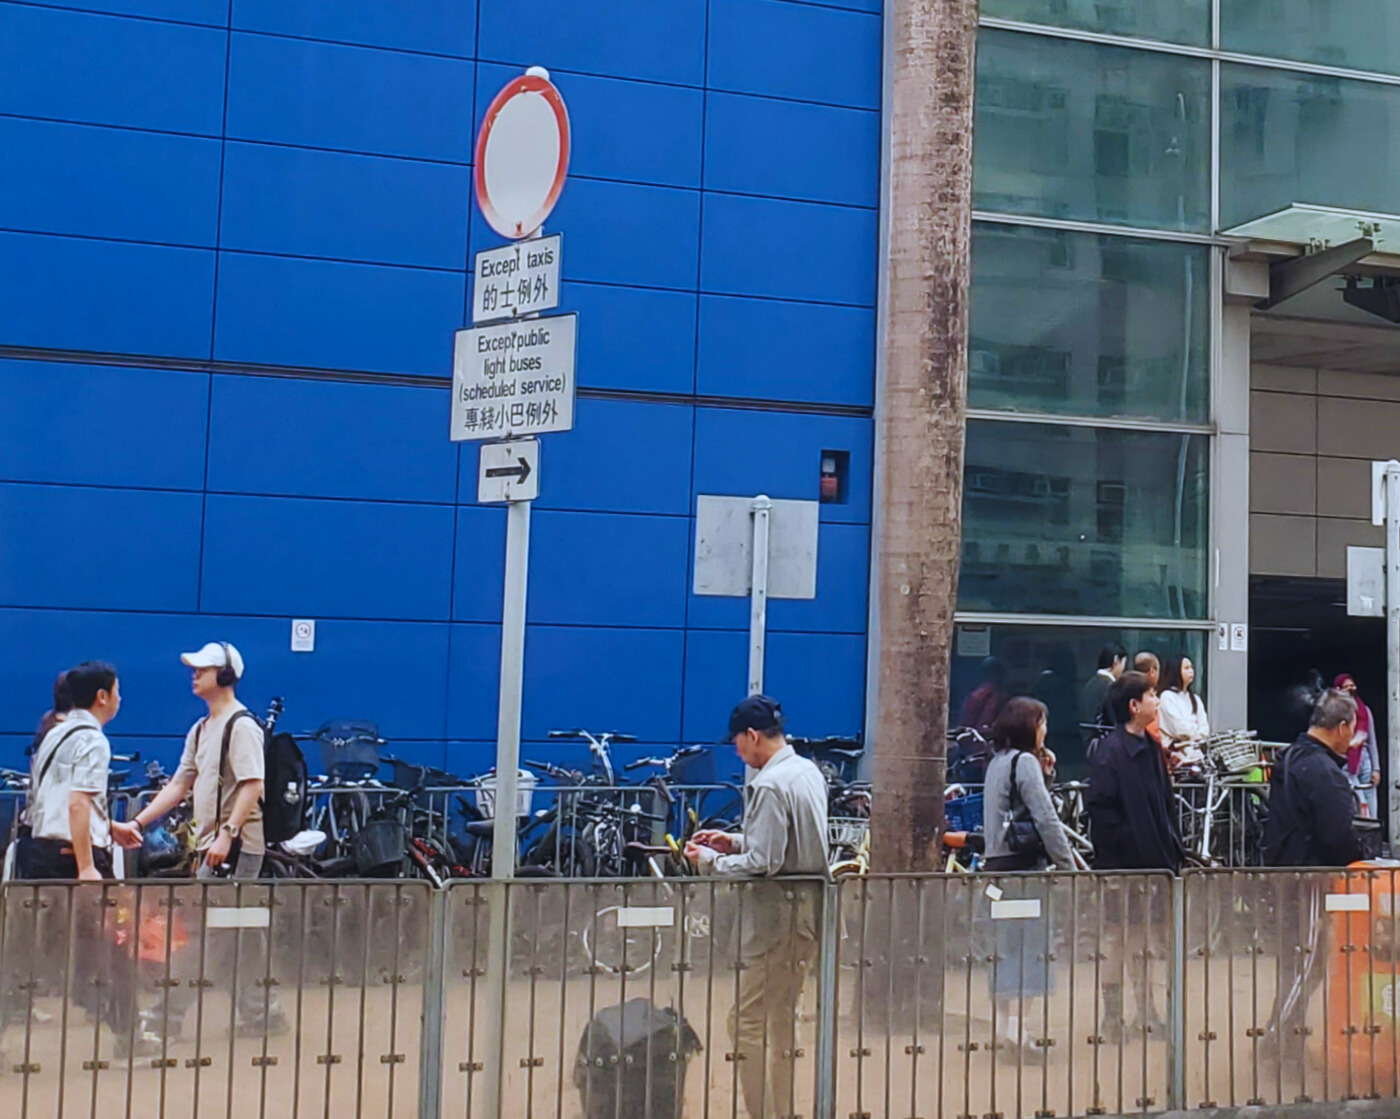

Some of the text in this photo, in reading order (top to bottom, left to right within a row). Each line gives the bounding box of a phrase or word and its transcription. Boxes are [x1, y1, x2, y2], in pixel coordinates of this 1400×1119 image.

[481, 247, 554, 278] Except taxis
[483, 273, 548, 312] 的士例外
[478, 328, 550, 354] Except public
[484, 355, 542, 380] light buses
[459, 372, 566, 403] (scheduled service)
